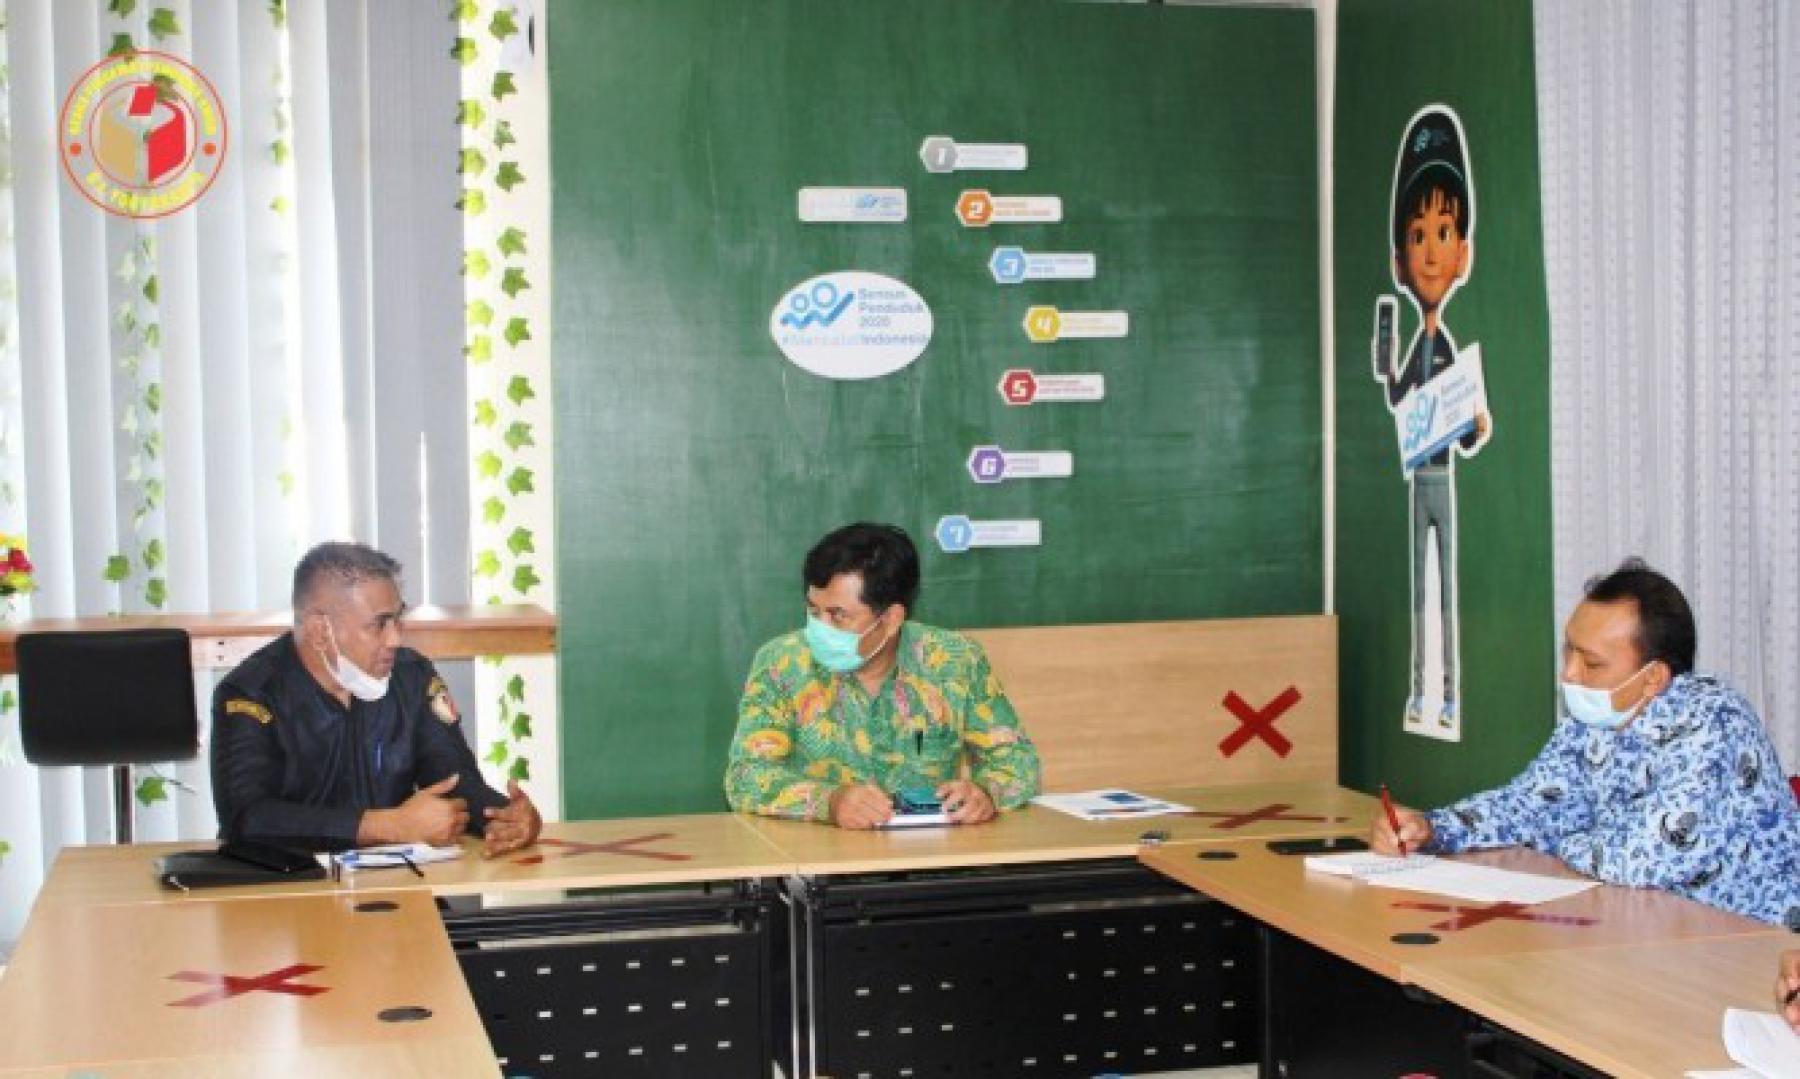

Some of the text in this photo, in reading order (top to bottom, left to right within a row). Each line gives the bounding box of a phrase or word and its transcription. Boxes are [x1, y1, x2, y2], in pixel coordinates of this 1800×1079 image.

[968, 202, 985, 219] 2
[1003, 258, 1018, 276] 3
[1036, 317, 1052, 334] 4
[1011, 380, 1029, 398] 5
[981, 458, 997, 475] 6
[949, 525, 964, 544] 7
